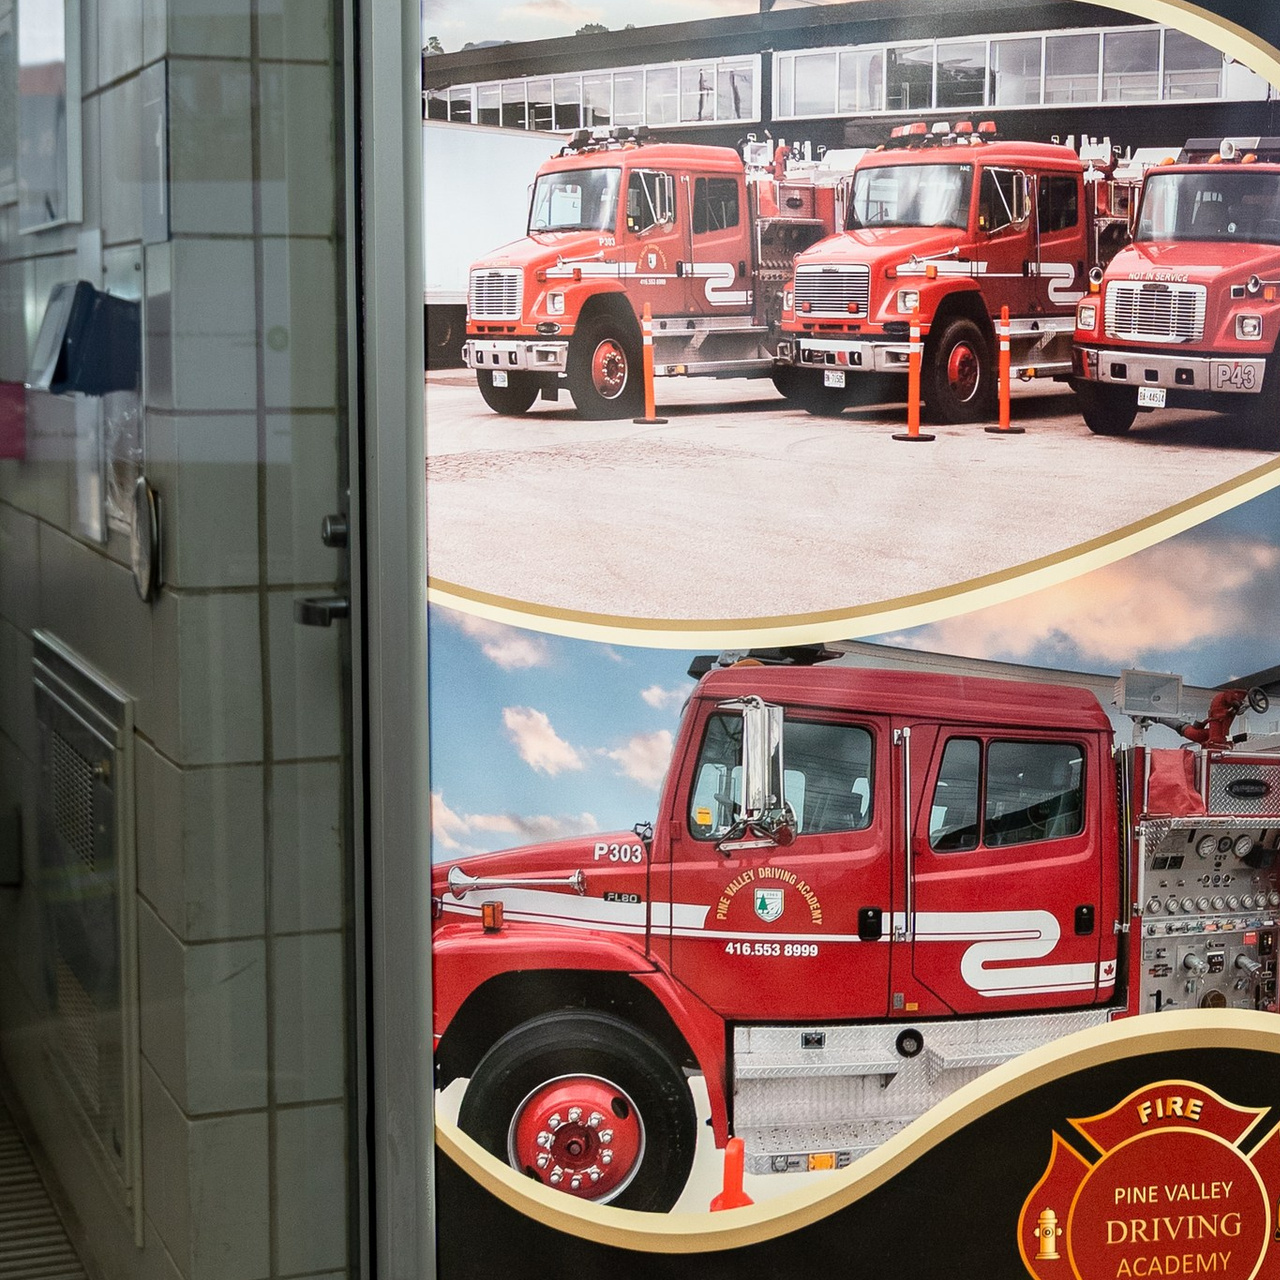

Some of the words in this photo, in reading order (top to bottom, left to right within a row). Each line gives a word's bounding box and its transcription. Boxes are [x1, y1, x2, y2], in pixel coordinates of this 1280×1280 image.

[1217, 364, 1256, 389] P43
[594, 843, 642, 863] P303
[606, 892, 638, 903] FL80
[716, 896, 731, 920] PINE
[724, 869, 756, 897] VALLEY
[758, 867, 797, 885] DRIVING
[795, 880, 823, 925] ACADEMY
[725, 942, 781, 956] 416.553
[784, 944, 819, 957] 8999
[1136, 1096, 1203, 1125] FIRE
[1115, 1185, 1158, 1205] PINE
[1164, 1181, 1233, 1202] VALLEY
[1106, 1212, 1242, 1245] DRIVING
[1116, 1251, 1232, 1278] ACADEMY
